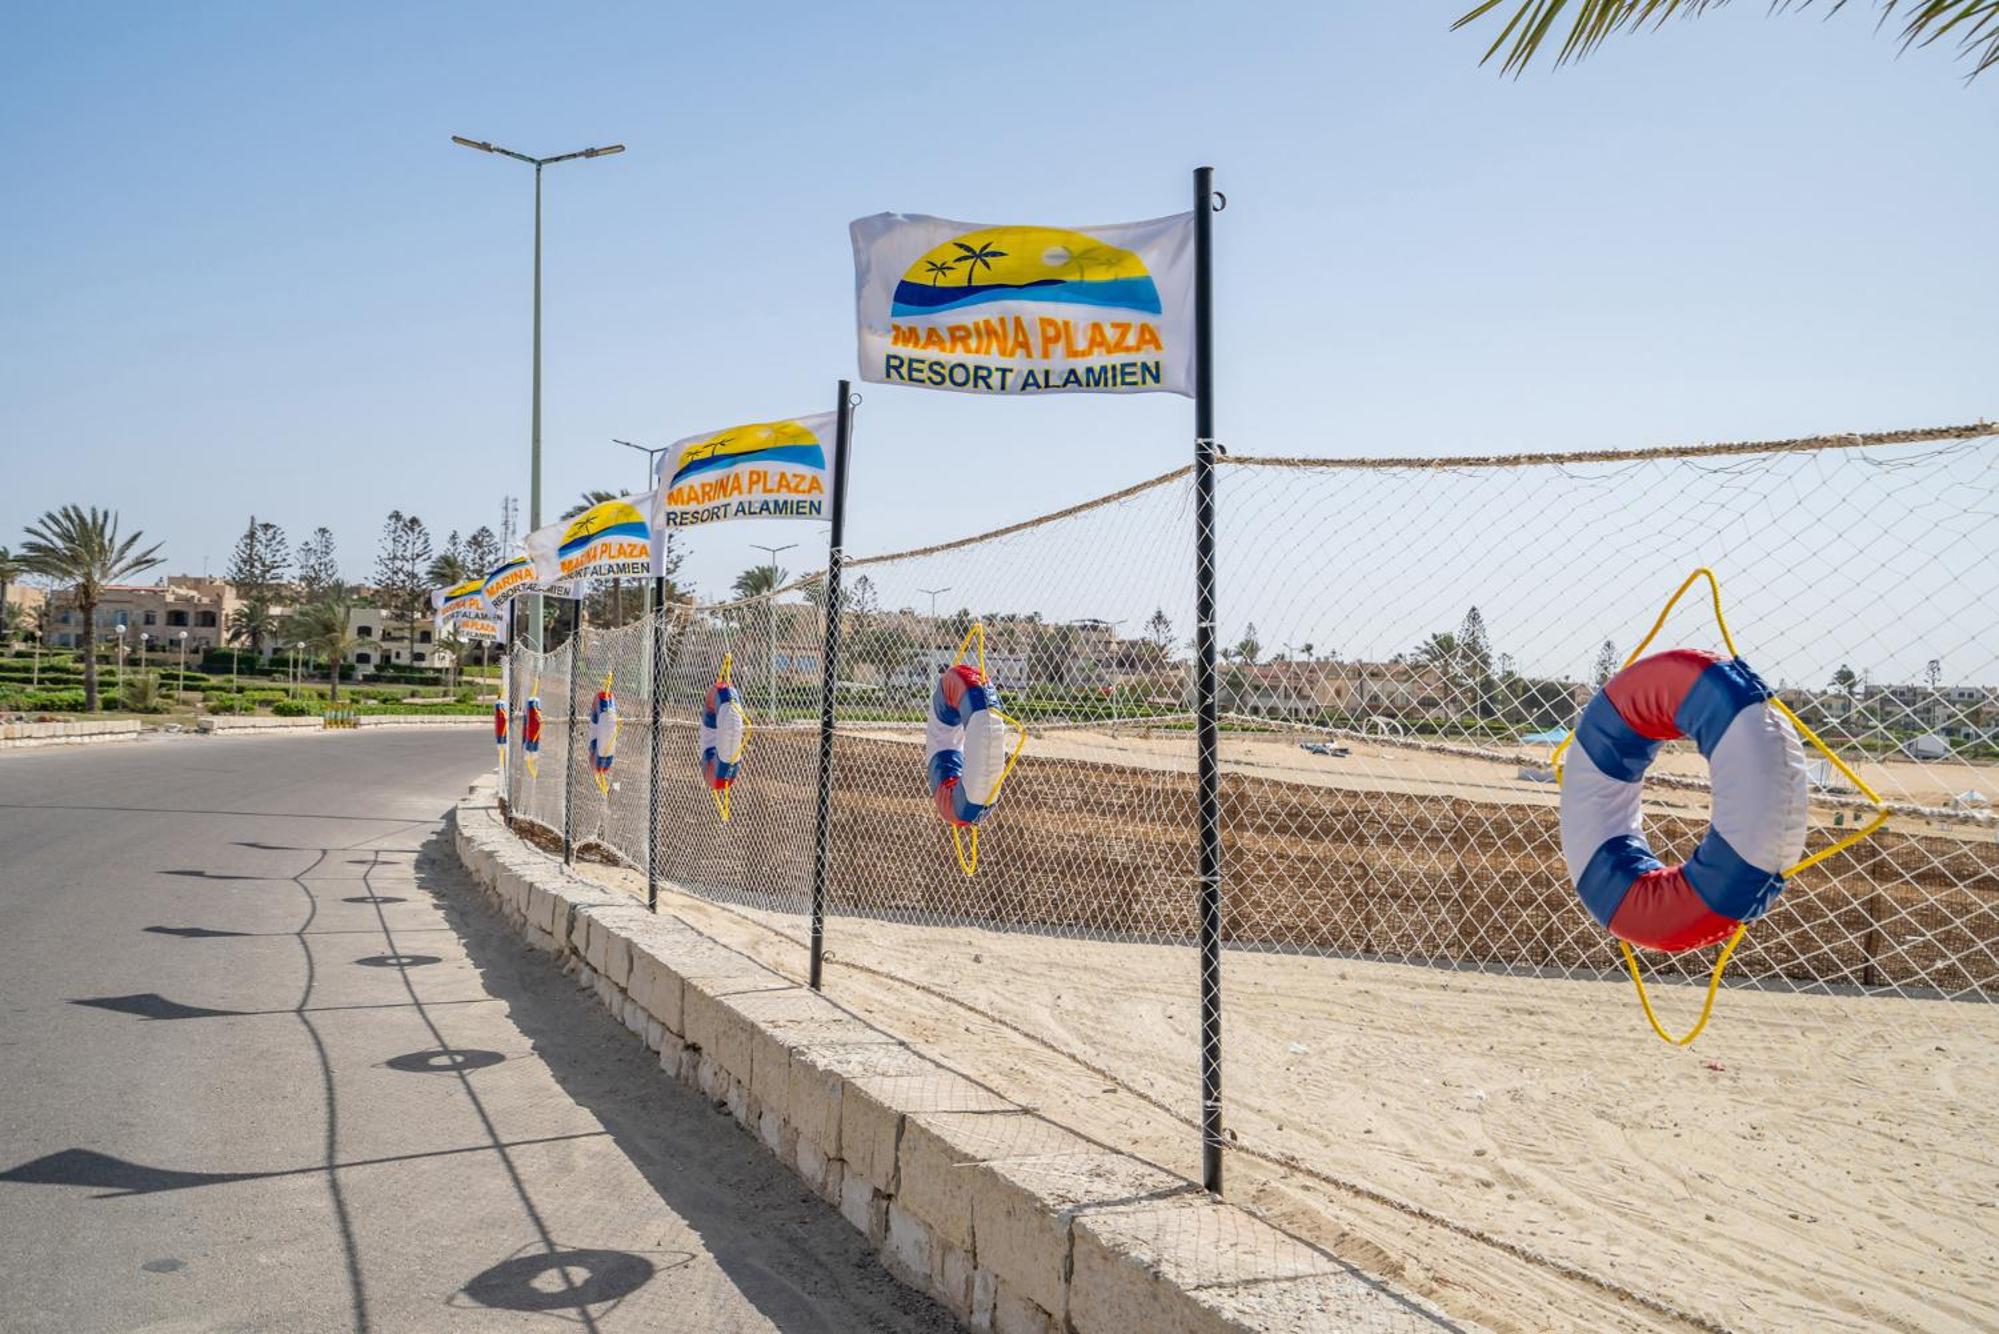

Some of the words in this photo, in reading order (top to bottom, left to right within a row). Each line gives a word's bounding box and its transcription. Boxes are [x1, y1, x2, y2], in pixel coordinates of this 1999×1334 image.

[891, 316, 1033, 359] MARINA
[1039, 317, 1163, 360] PLAZA
[885, 354, 1013, 391] RESORT
[1020, 361, 1161, 392] ALAMIEN
[667, 473, 744, 506] MARINA
[749, 470, 824, 495] PLAZA
[666, 503, 731, 527] RESORT
[734, 500, 822, 516] ALAMIEN
[599, 543, 650, 560] PLAZA
[486, 567, 534, 597] MARINA
[590, 562, 650, 577] ALAMIEN
[491, 583, 526, 608] RESORT
